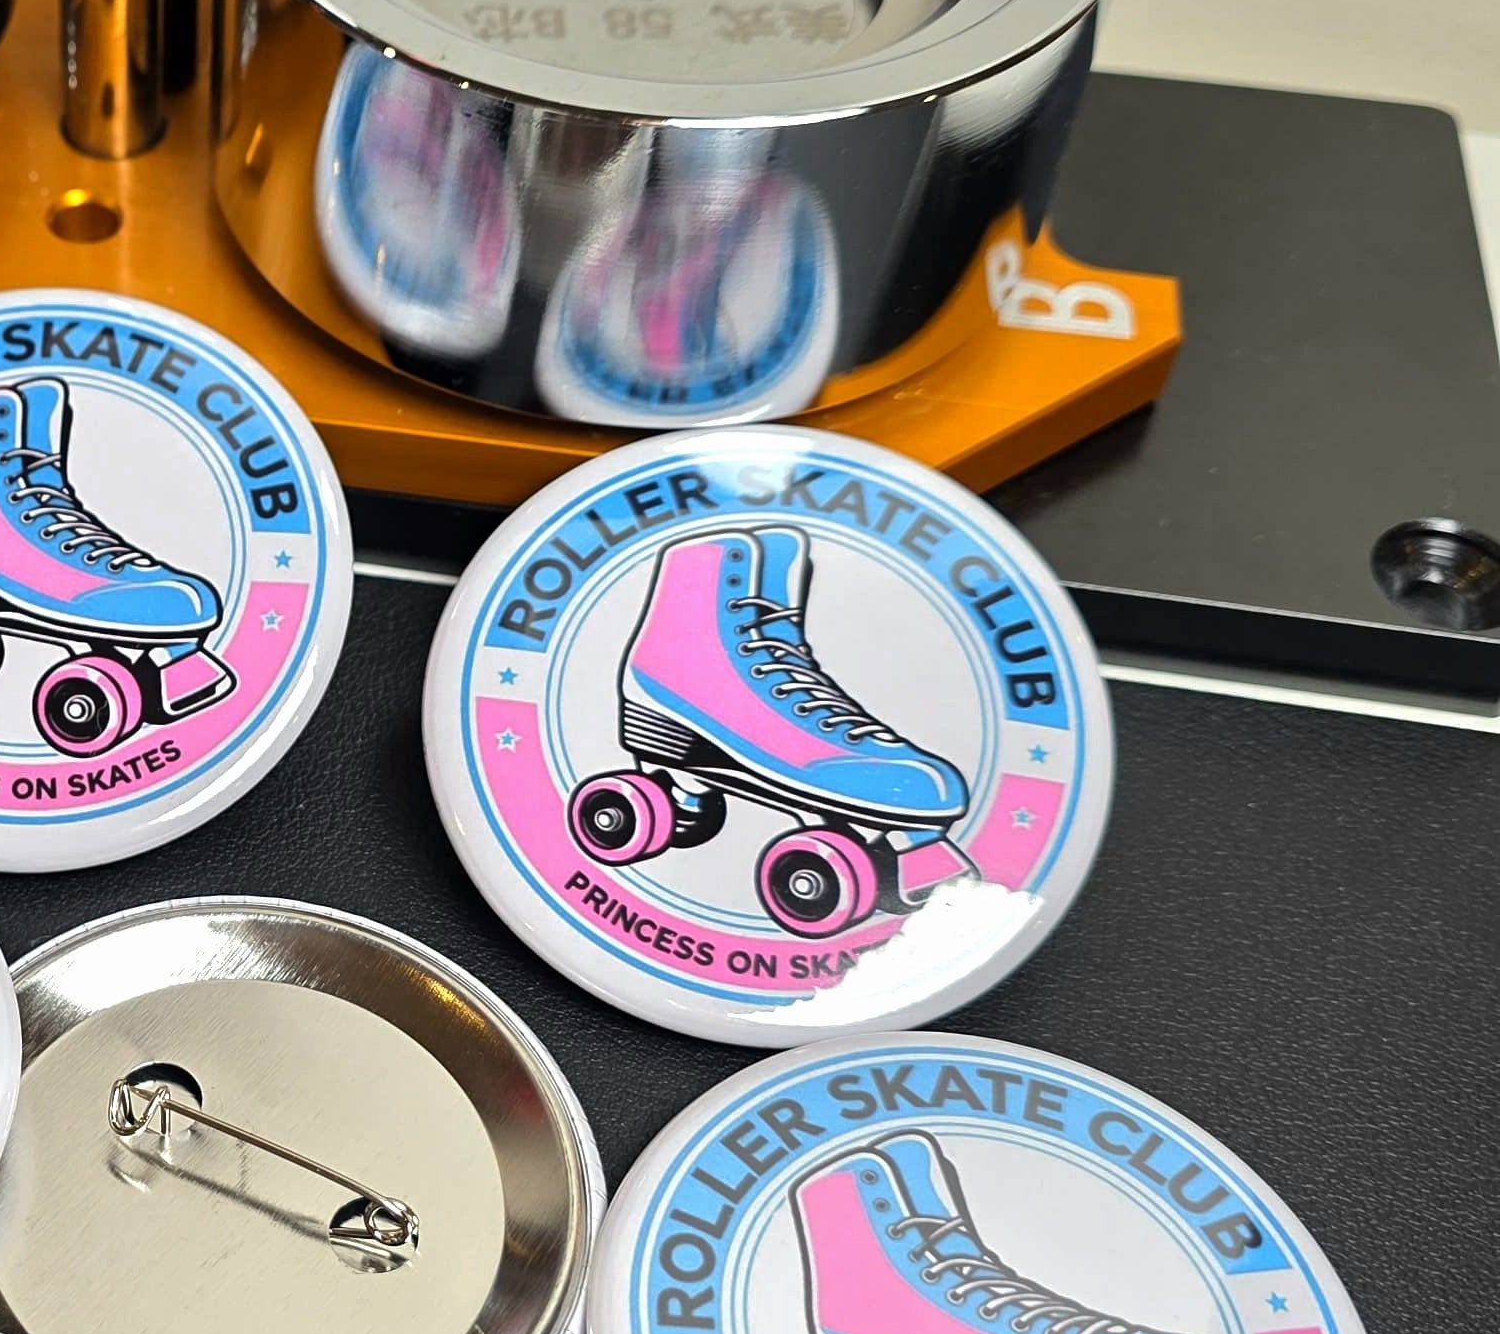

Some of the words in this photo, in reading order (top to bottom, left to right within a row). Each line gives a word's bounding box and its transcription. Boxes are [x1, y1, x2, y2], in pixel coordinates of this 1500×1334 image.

[604, 6, 674, 40] 58
[997, 277, 1137, 341] B
[2, 319, 198, 395] SKATE
[195, 381, 300, 521] CLUB
[496, 470, 716, 643] ROLLER
[735, 464, 955, 563] SKATE
[947, 552, 1058, 712] CLUB
[11, 776, 58, 801] ON
[66, 739, 184, 800] SKATES
[563, 869, 716, 968] PRINCESS
[726, 950, 779, 980] ON
[788, 932, 902, 981] SKA
[655, 1095, 828, 1331] ROLLER
[826, 1064, 1070, 1131] SKATE
[1085, 1111, 1266, 1262] CLUB
